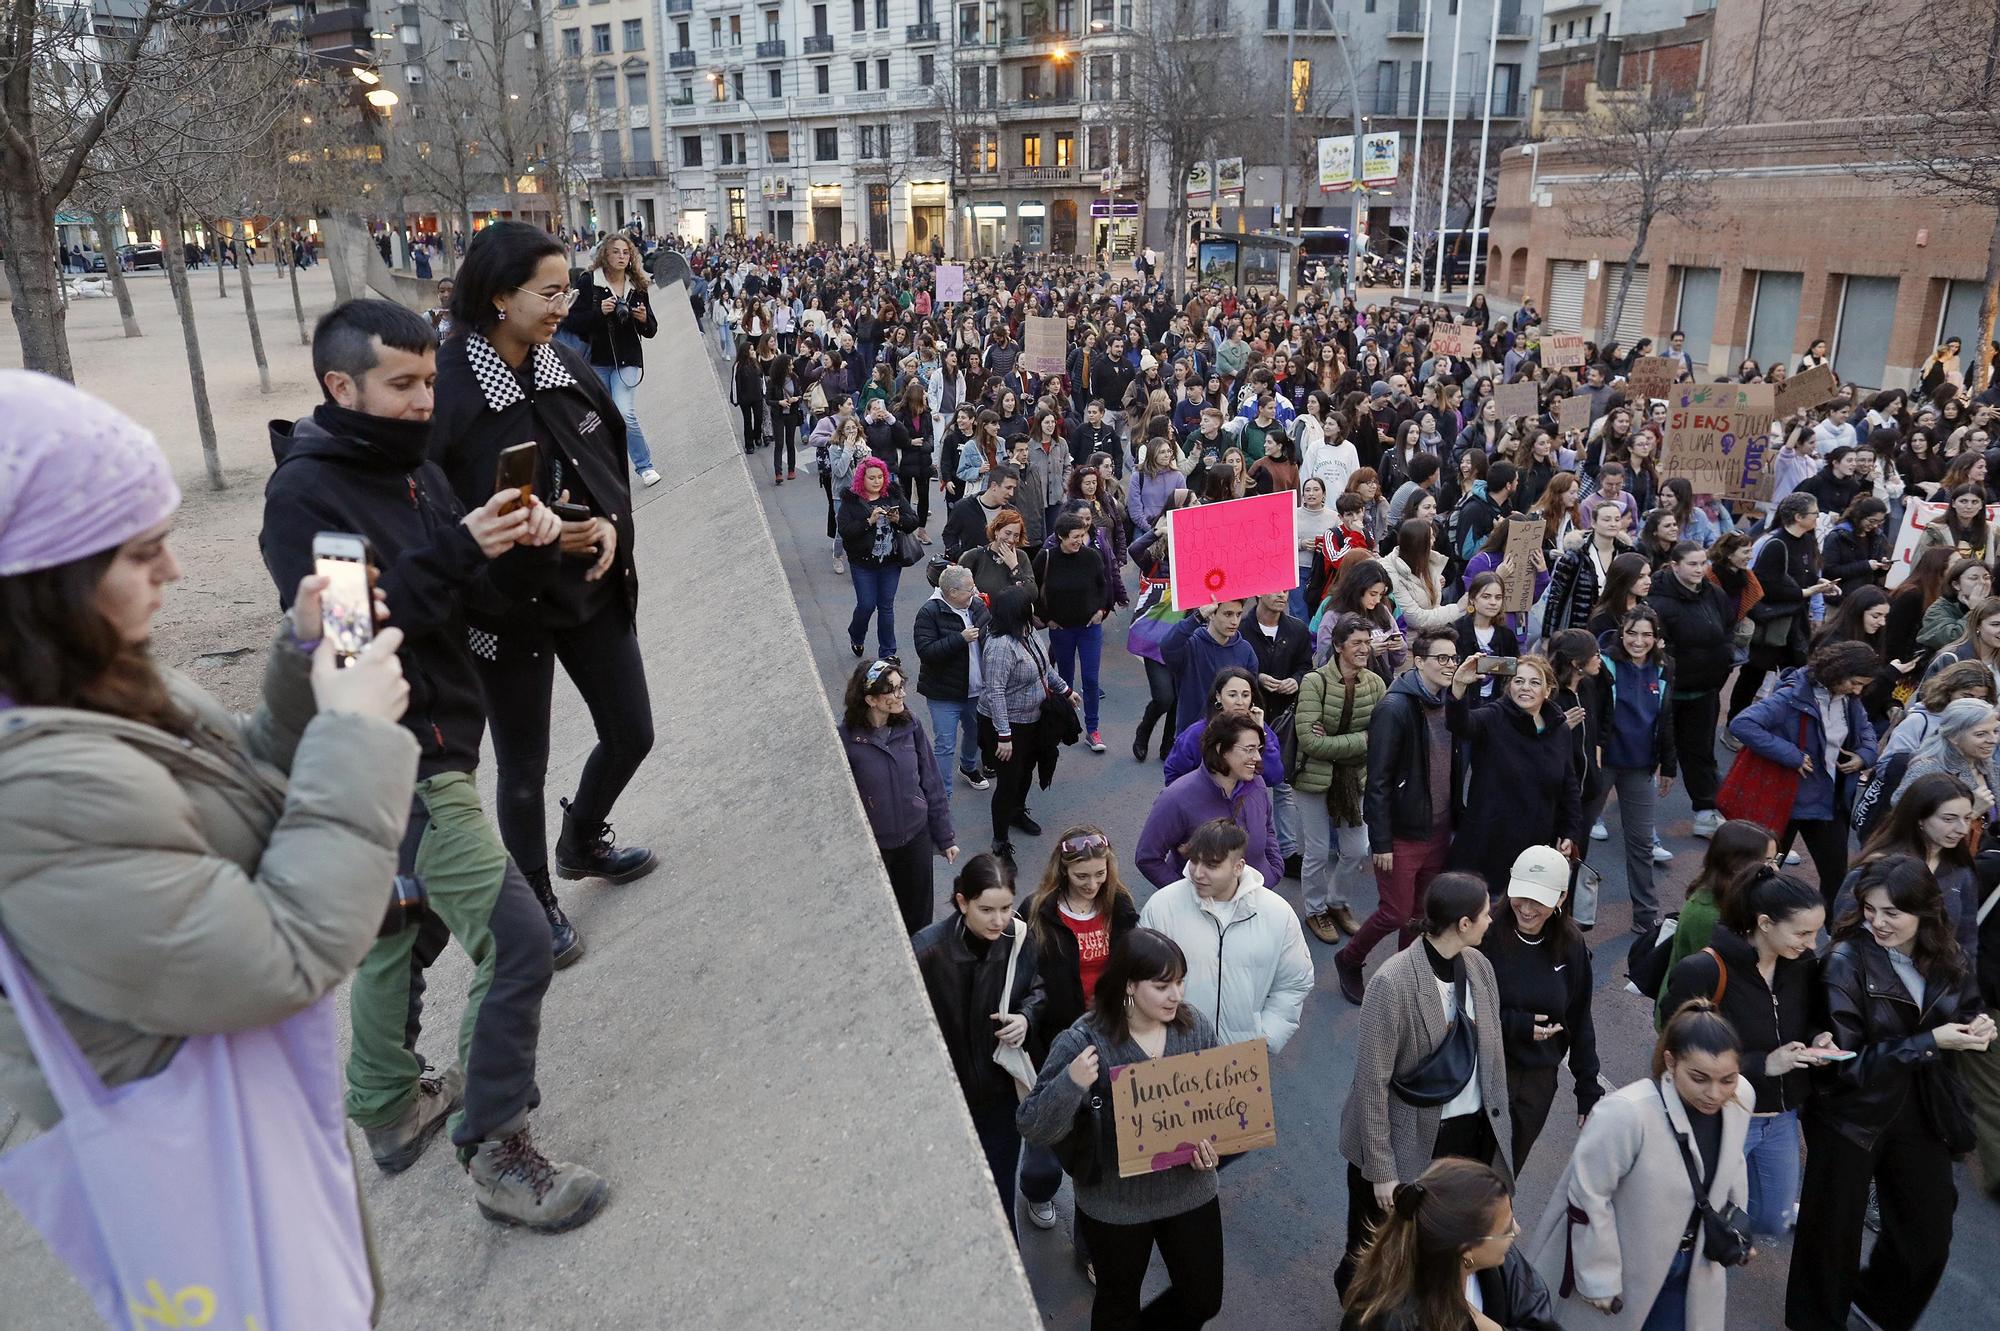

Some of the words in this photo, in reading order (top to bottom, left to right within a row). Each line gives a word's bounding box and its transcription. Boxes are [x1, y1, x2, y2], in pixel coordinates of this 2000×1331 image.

[1432, 339, 1462, 355] SOLA
[1694, 414, 1730, 433] ENS
[1670, 432, 1683, 453] A
[1689, 432, 1714, 453] UNA
[1532, 526, 1542, 540] LA
[1131, 1113, 1143, 1138] y
[1192, 1096, 1248, 1125] miedo
